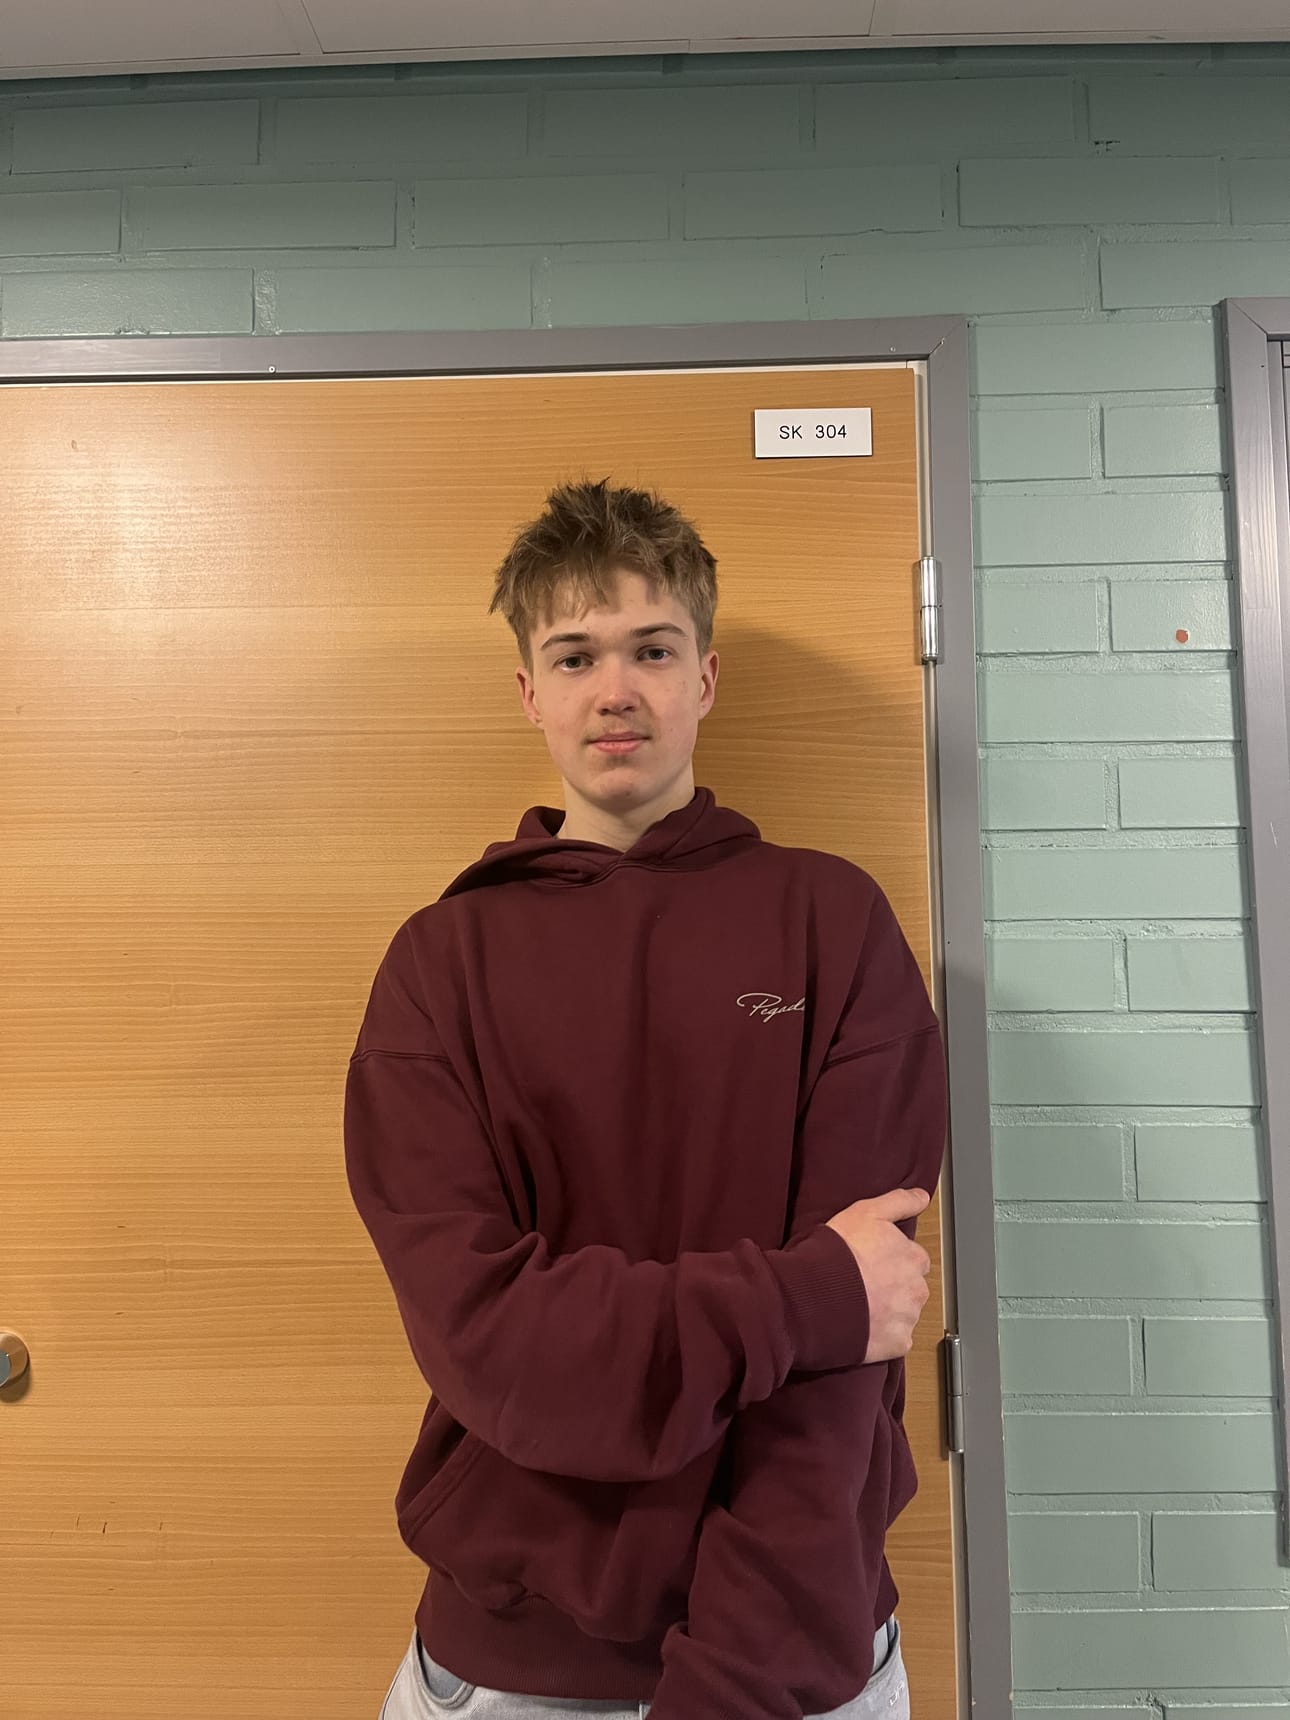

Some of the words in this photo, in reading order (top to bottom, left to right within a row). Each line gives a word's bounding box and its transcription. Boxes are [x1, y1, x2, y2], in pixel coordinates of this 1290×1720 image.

[779, 425, 803, 440] SK
[815, 424, 847, 439] 304
[736, 992, 806, 1023] Pegad
